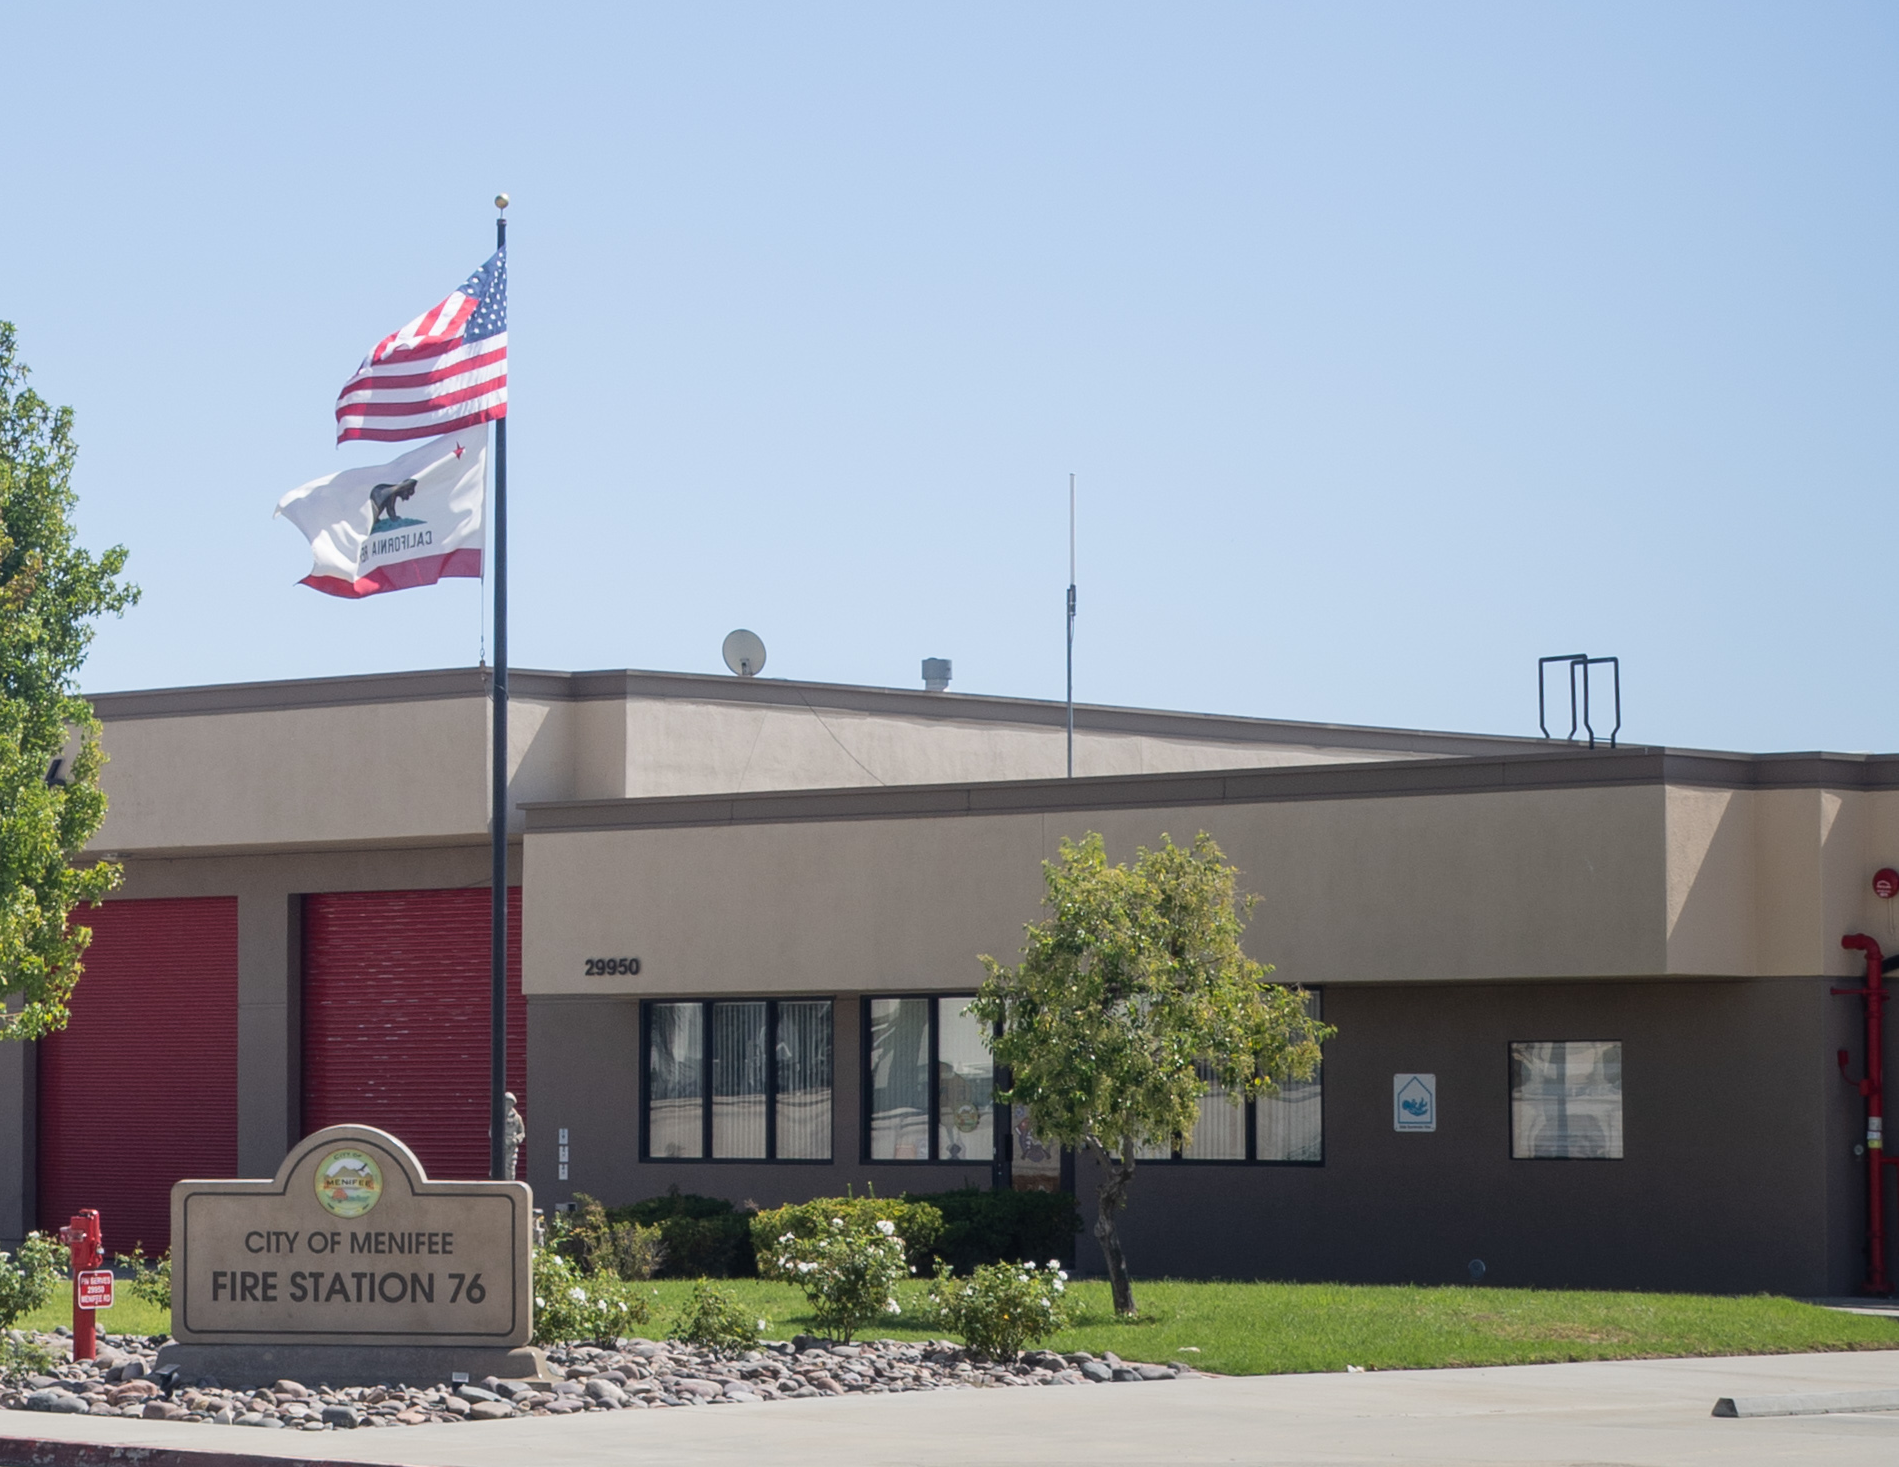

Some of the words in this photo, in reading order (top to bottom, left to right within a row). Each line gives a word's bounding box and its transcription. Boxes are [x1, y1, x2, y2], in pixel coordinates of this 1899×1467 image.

[585, 958, 640, 976] 29950
[244, 1231, 299, 1254] CITY
[307, 1231, 342, 1254] OF
[350, 1232, 454, 1255] MENIFEE
[212, 1271, 278, 1302] FIRE
[289, 1271, 435, 1304] STATION
[448, 1272, 487, 1305] 76
